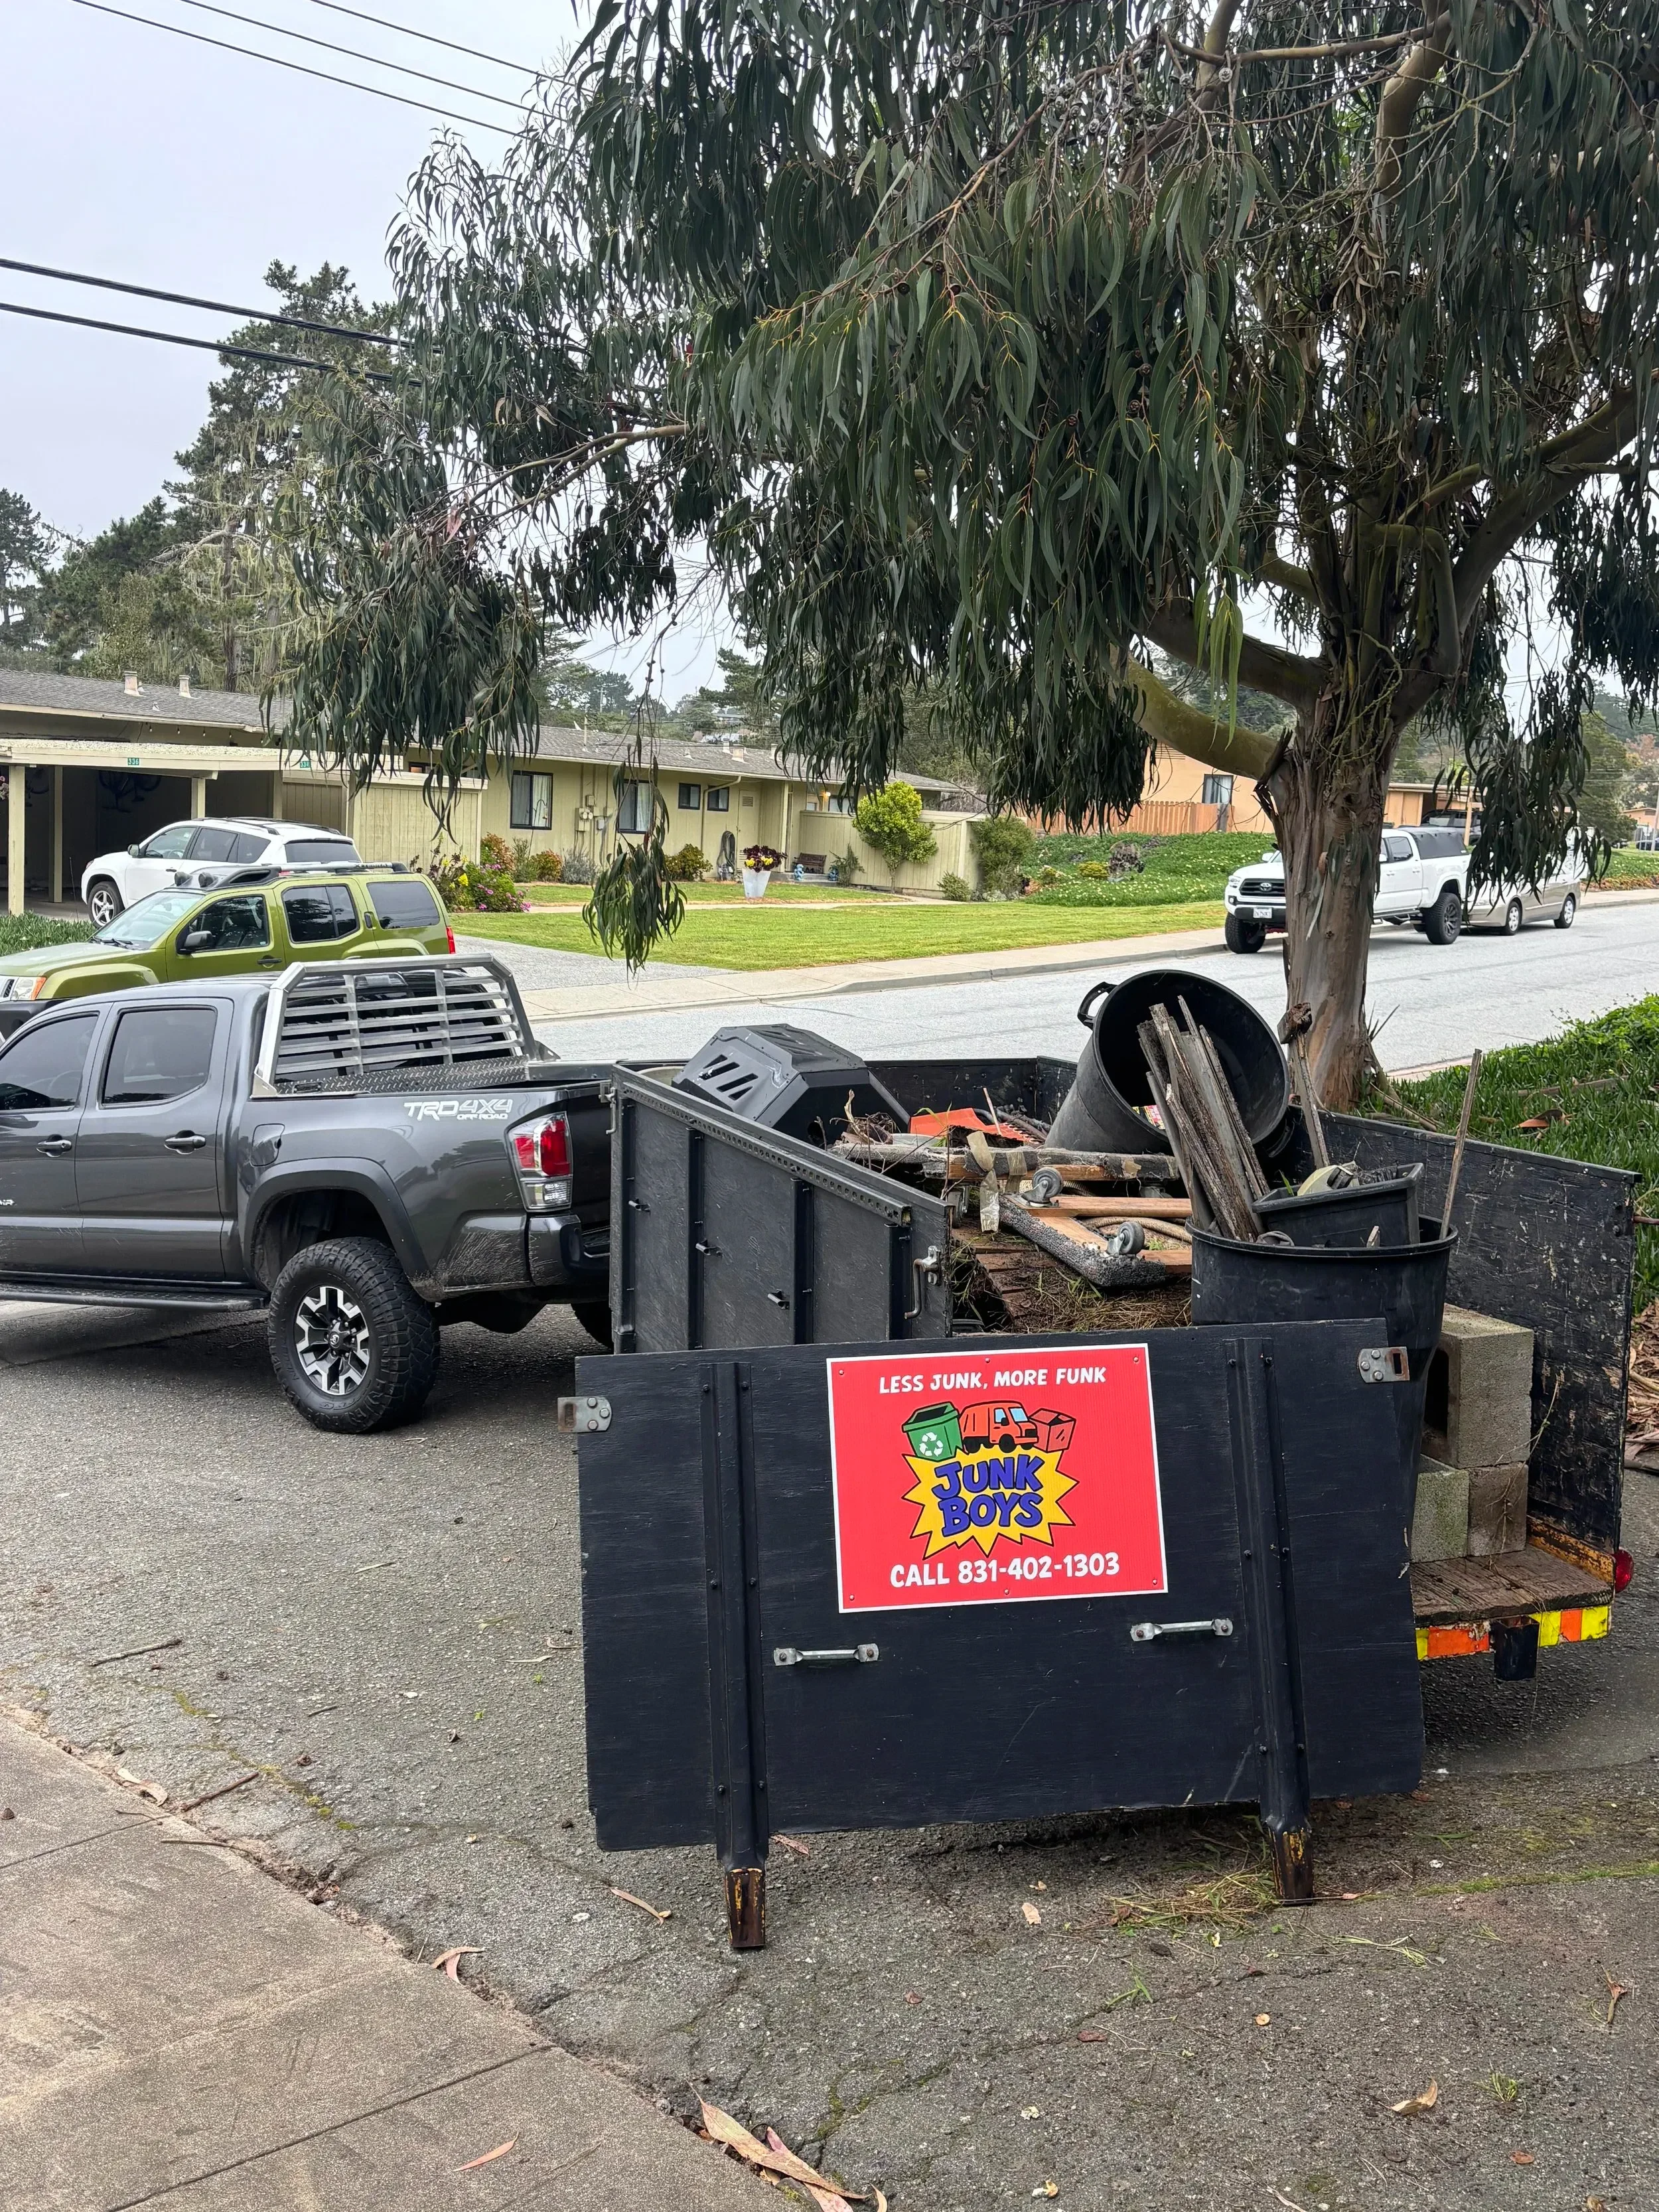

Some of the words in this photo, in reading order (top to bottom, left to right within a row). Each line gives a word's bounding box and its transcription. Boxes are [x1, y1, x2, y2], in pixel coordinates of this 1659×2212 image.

[403, 1100, 460, 1122] TRD
[879, 1374, 924, 1394] LESS
[930, 1372, 988, 1391] JUNK,
[993, 1368, 1048, 1387] MORE
[1056, 1366, 1107, 1385] FUNK
[932, 1454, 1045, 1500] JUNK
[938, 1492, 1043, 1537] BOYS
[890, 1562, 950, 1588] CALL
[958, 1552, 1120, 1584] 831-402-1303
